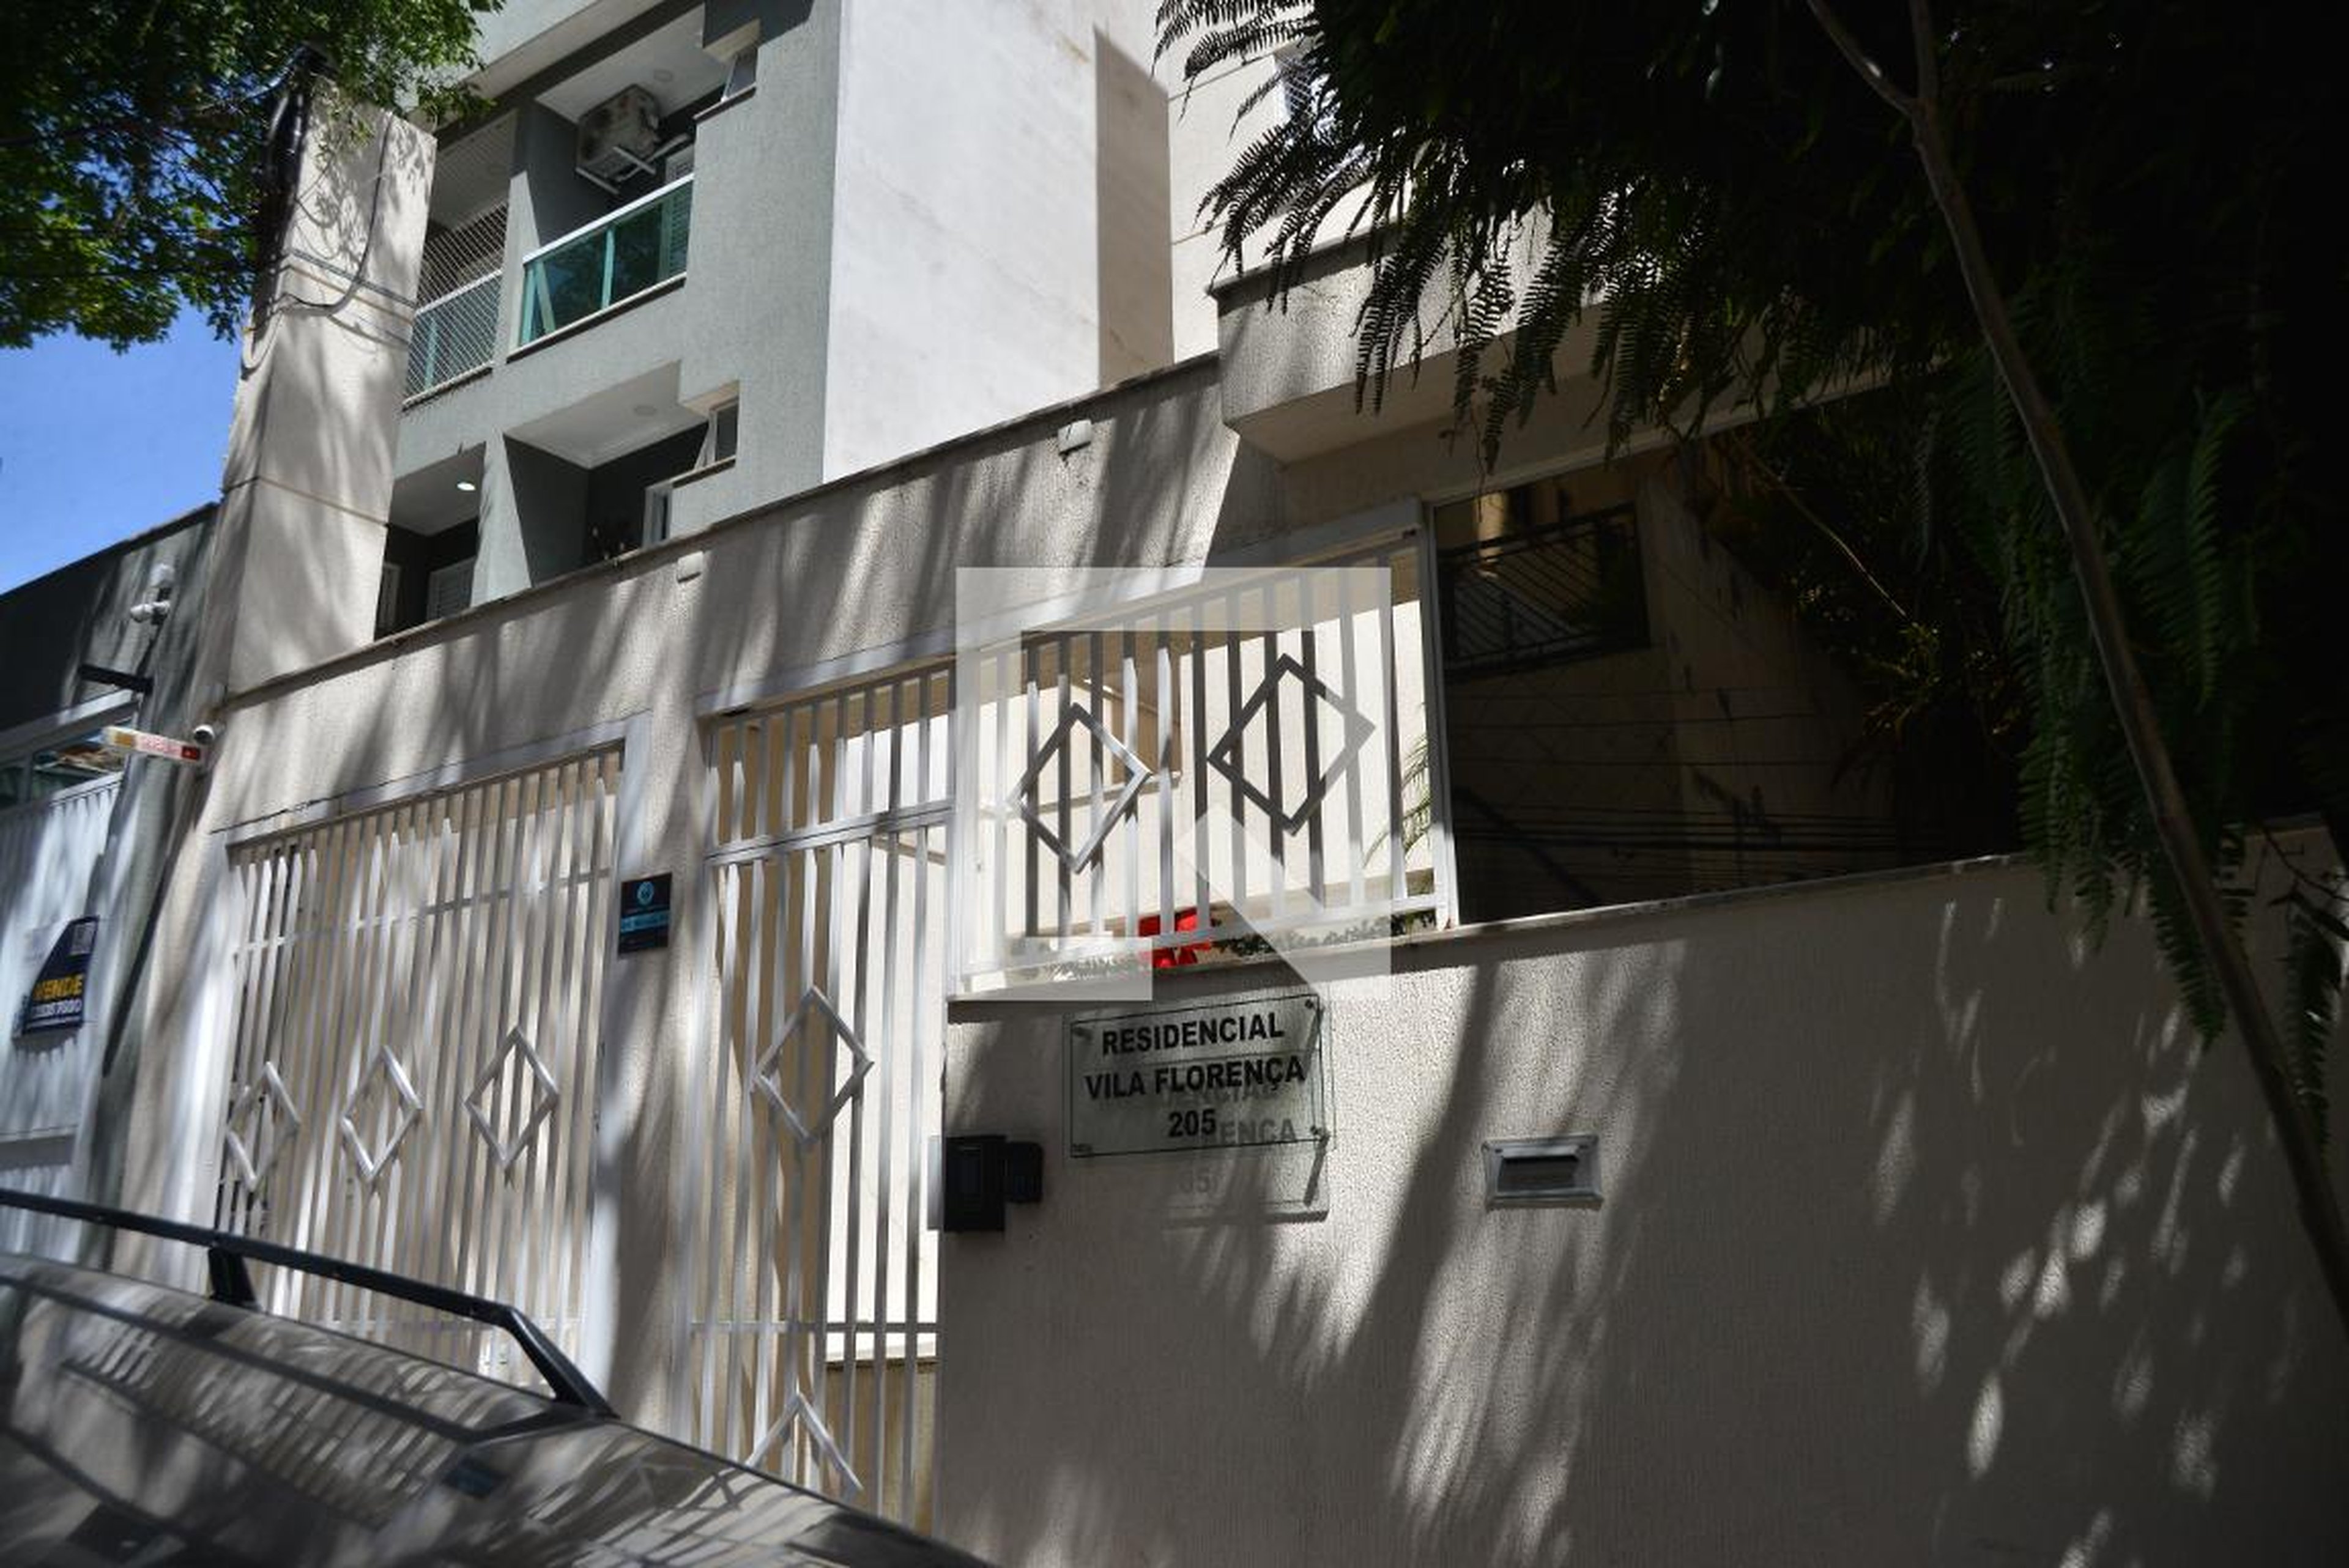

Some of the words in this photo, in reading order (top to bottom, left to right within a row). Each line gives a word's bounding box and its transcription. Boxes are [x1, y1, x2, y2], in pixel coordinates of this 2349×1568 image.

[1102, 1012, 1284, 1056] RESIDENCIAL
[1085, 1074, 1145, 1100] VILA
[1154, 1055, 1306, 1093] FLORENÇA
[1168, 1108, 1217, 1138] 205
